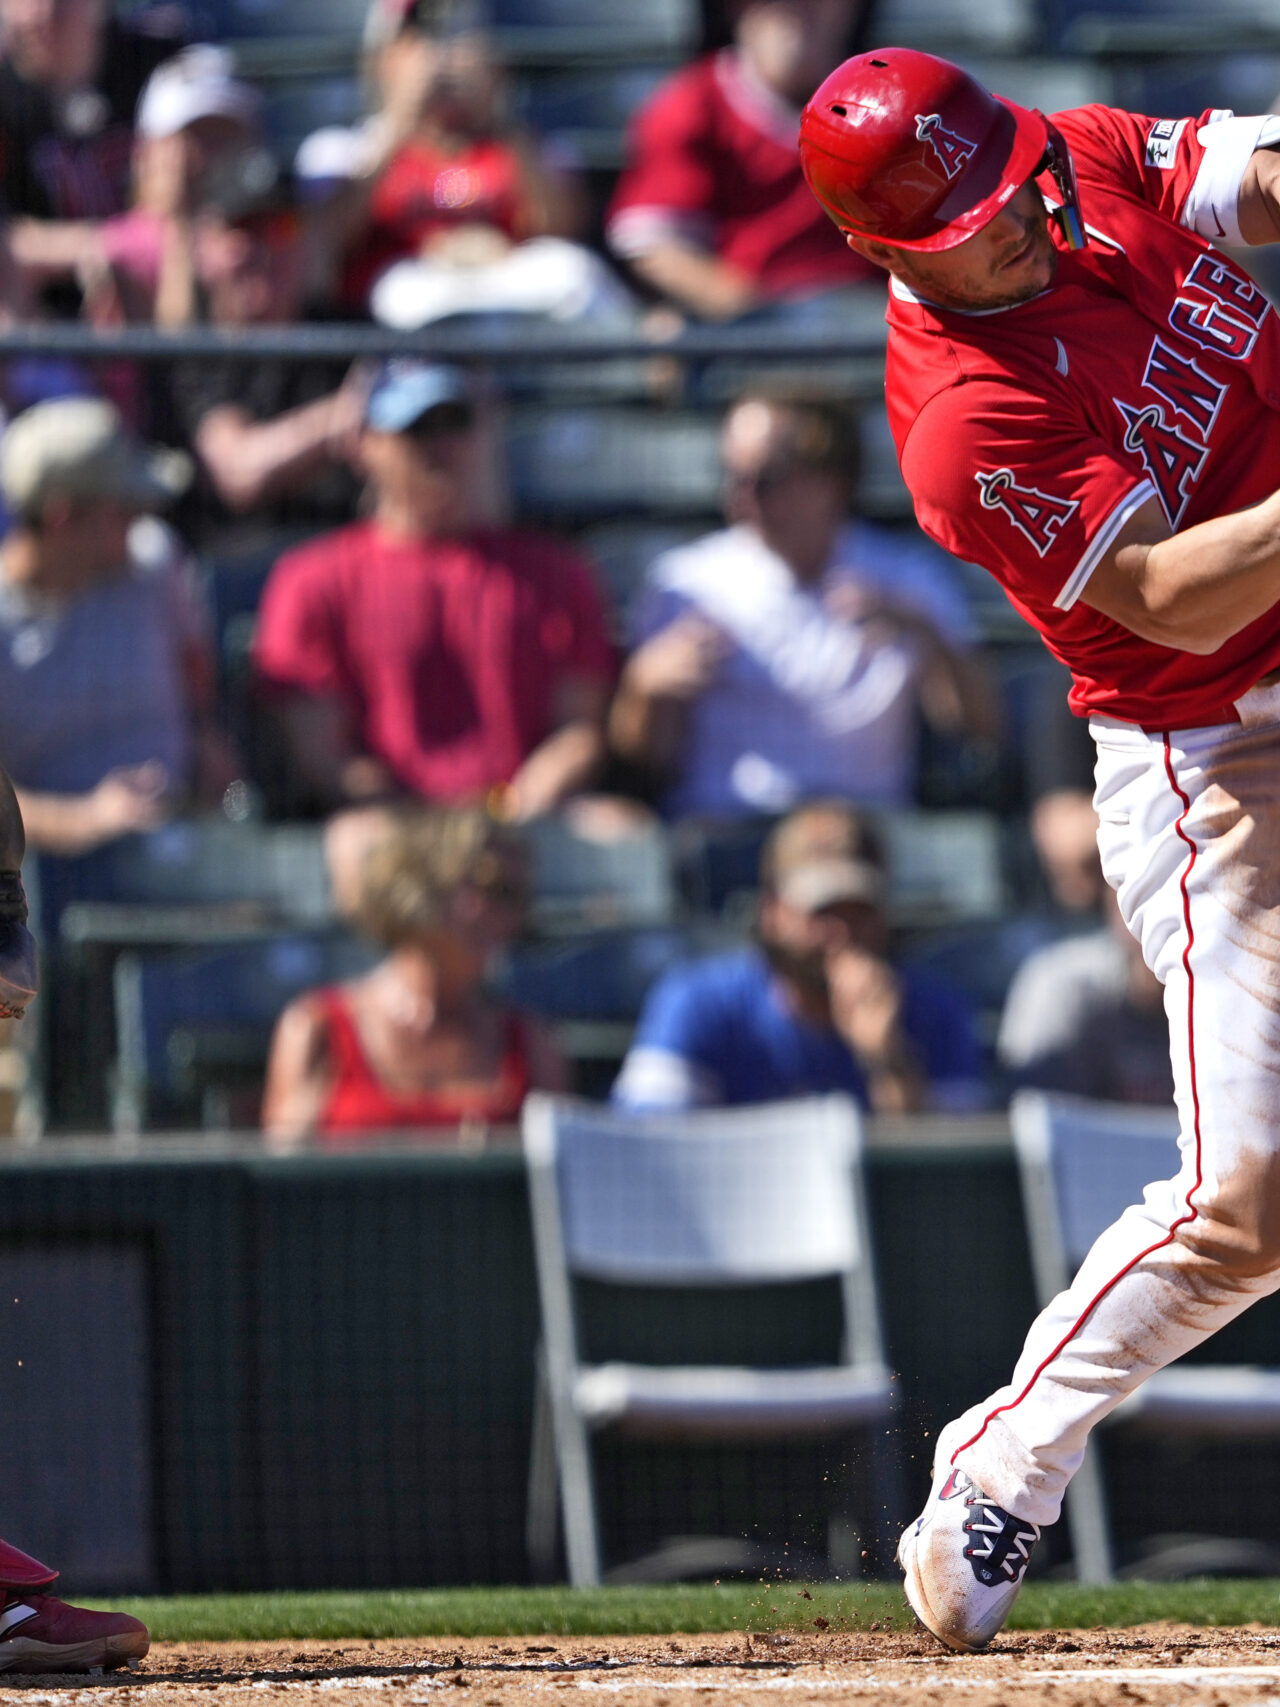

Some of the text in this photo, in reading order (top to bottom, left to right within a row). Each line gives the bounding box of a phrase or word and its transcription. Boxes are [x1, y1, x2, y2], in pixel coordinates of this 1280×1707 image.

[914, 114, 978, 180] A
[1112, 243, 1272, 534] ANGE
[974, 468, 1080, 558] A
